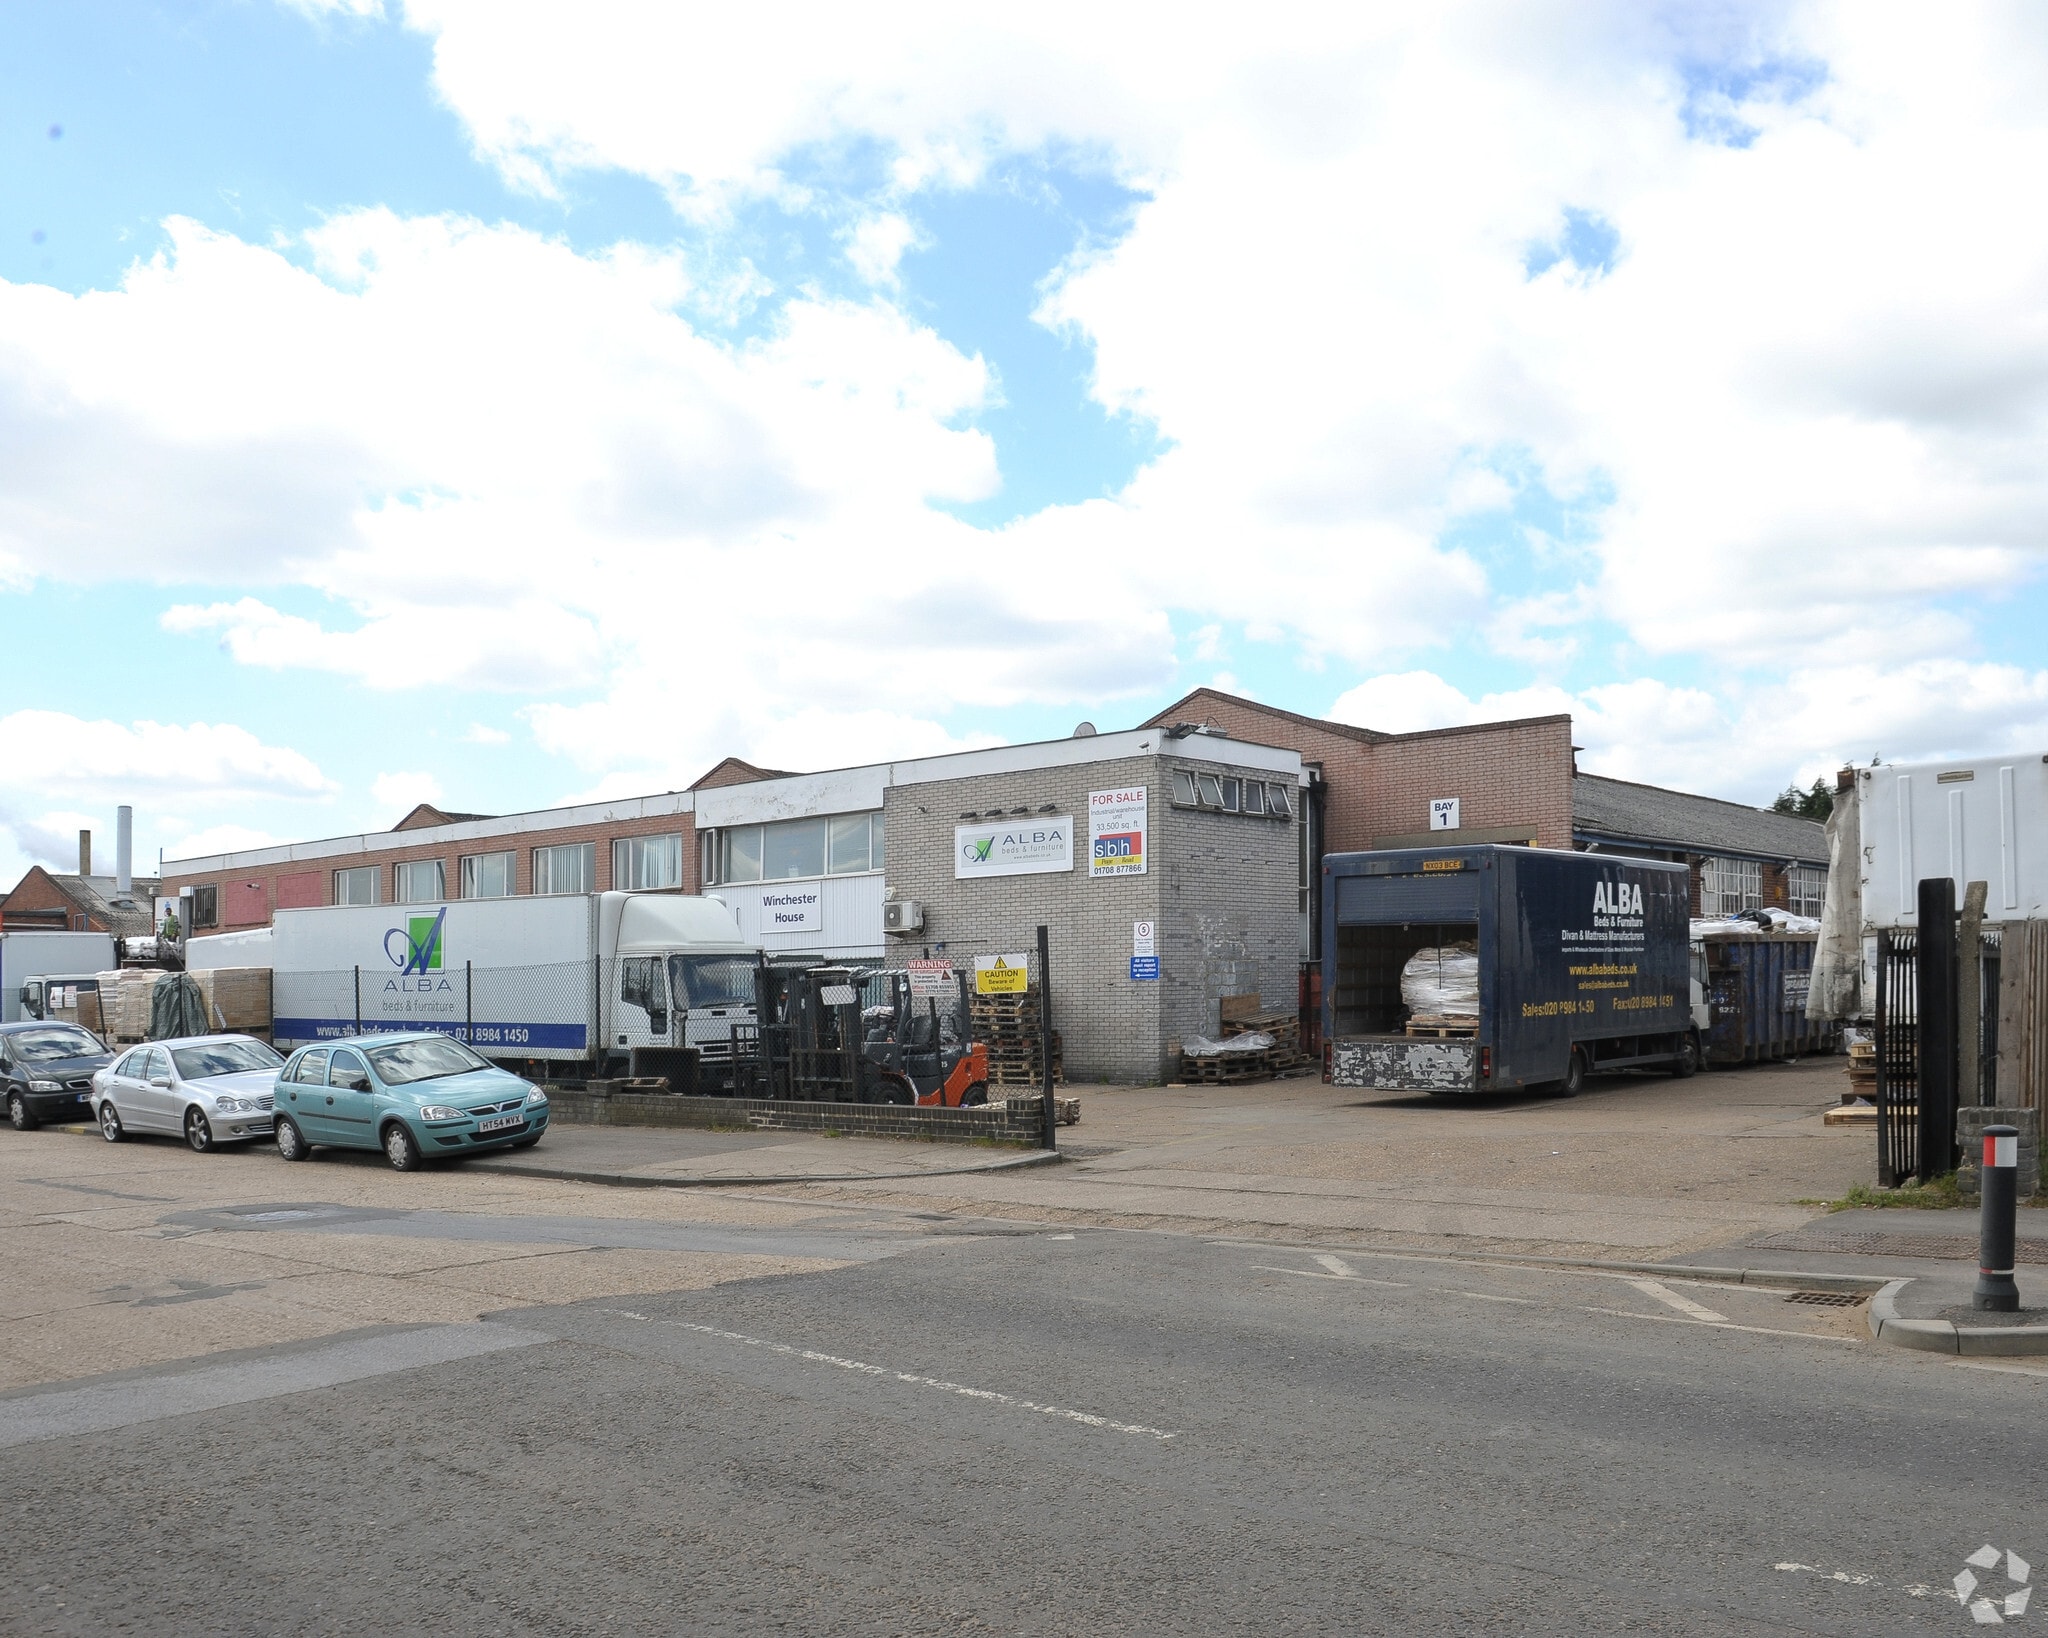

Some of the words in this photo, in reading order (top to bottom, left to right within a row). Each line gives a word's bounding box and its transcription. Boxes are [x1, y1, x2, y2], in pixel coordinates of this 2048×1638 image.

[1092, 794, 1113, 806] FOR
[1116, 791, 1144, 803] SALE
[1434, 802, 1454, 812] BAY
[1439, 812, 1447, 826] 1
[1096, 821, 1120, 832] 33,500
[1002, 830, 1063, 846] ALBA
[1001, 846, 1019, 854] beds
[1030, 843, 1064, 852] furniture
[1094, 866, 1115, 875] 01708
[762, 893, 818, 907] Winchester
[1592, 881, 1644, 915] ALBA
[775, 912, 805, 923] House
[1593, 916, 1609, 927] Beds
[1610, 916, 1616, 927] &
[1617, 916, 1644, 927] Furniture
[1561, 929, 1578, 940] Divan
[1579, 929, 1584, 940] &
[1584, 930, 1608, 940] Mattress
[1608, 930, 1645, 941] Manufacturers
[908, 960, 951, 969] WARNING
[1569, 963, 1638, 976] www.albabeds.co.uk
[984, 970, 1019, 978] CAUTION
[384, 979, 452, 992] ALBA
[383, 1000, 403, 1012] beds
[415, 1000, 454, 1012] furniture
[316, 1024, 409, 1036] www.albbedsco
[475, 1028, 501, 1042] 8984
[503, 1028, 529, 1042] 1450
[482, 1119, 504, 1131] HT54
[505, 1115, 521, 1125] MVX
